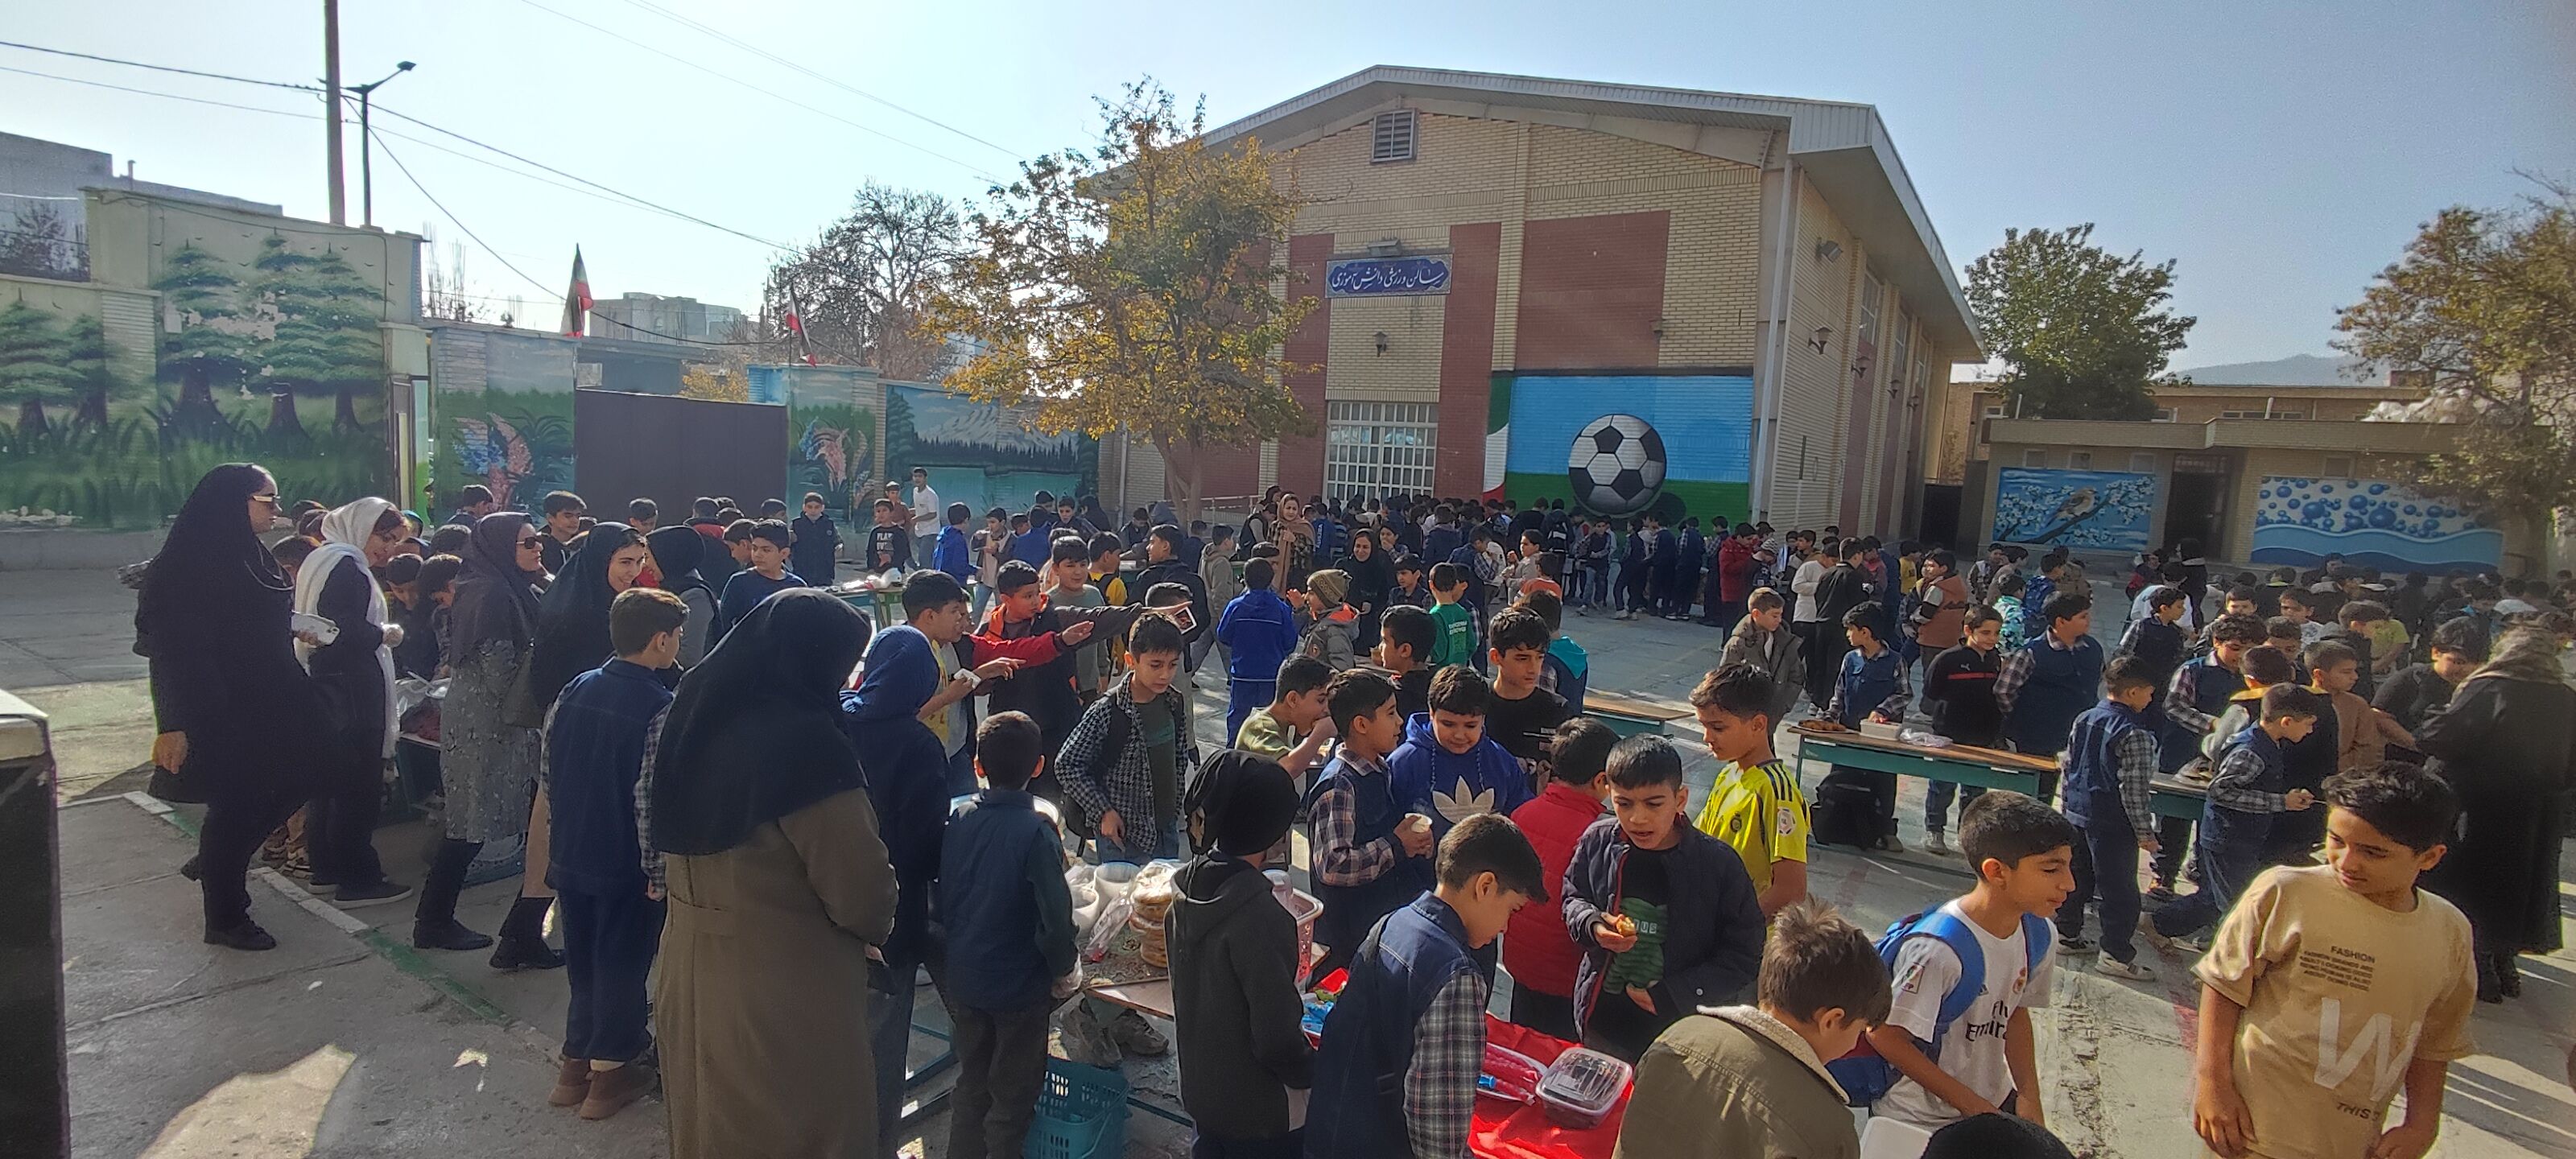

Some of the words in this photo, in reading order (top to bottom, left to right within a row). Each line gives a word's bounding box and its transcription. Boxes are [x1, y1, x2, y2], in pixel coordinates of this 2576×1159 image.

[1353, 266, 1383, 291] دانش
[1384, 267, 1406, 288] ورزشی
[2330, 946, 2376, 963] FASHION
